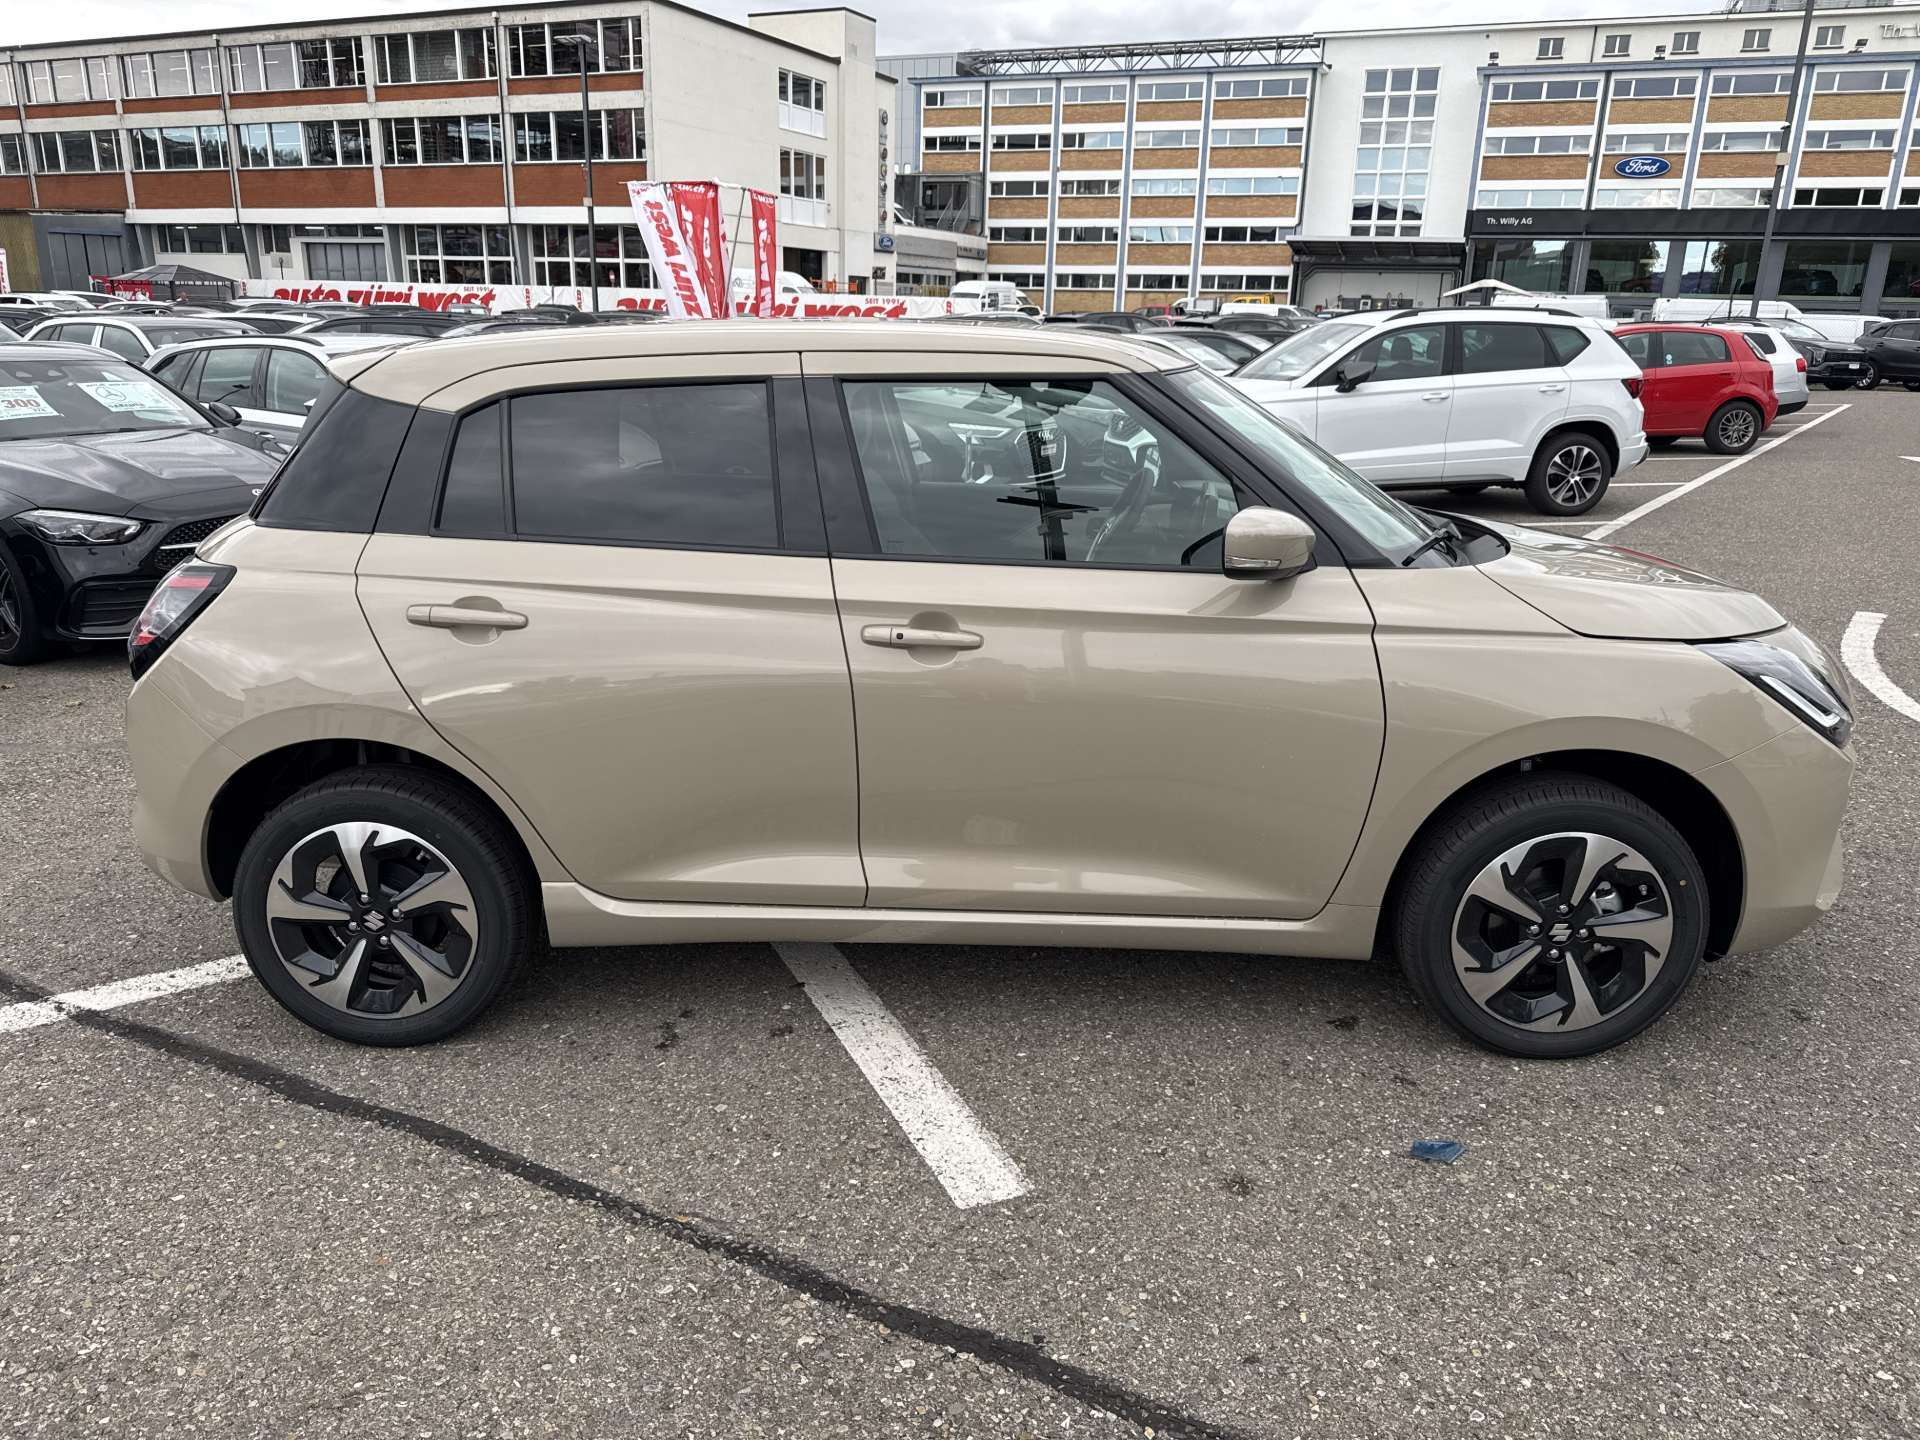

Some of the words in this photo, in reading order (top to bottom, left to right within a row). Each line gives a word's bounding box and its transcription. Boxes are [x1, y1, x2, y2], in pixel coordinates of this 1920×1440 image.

[1625, 159, 1658, 173] Ford
[643, 199, 682, 258] west
[1486, 217, 1498, 225] Th.
[1500, 217, 1519, 227] Willy
[1520, 217, 1533, 225] AG
[664, 261, 704, 318] züri
